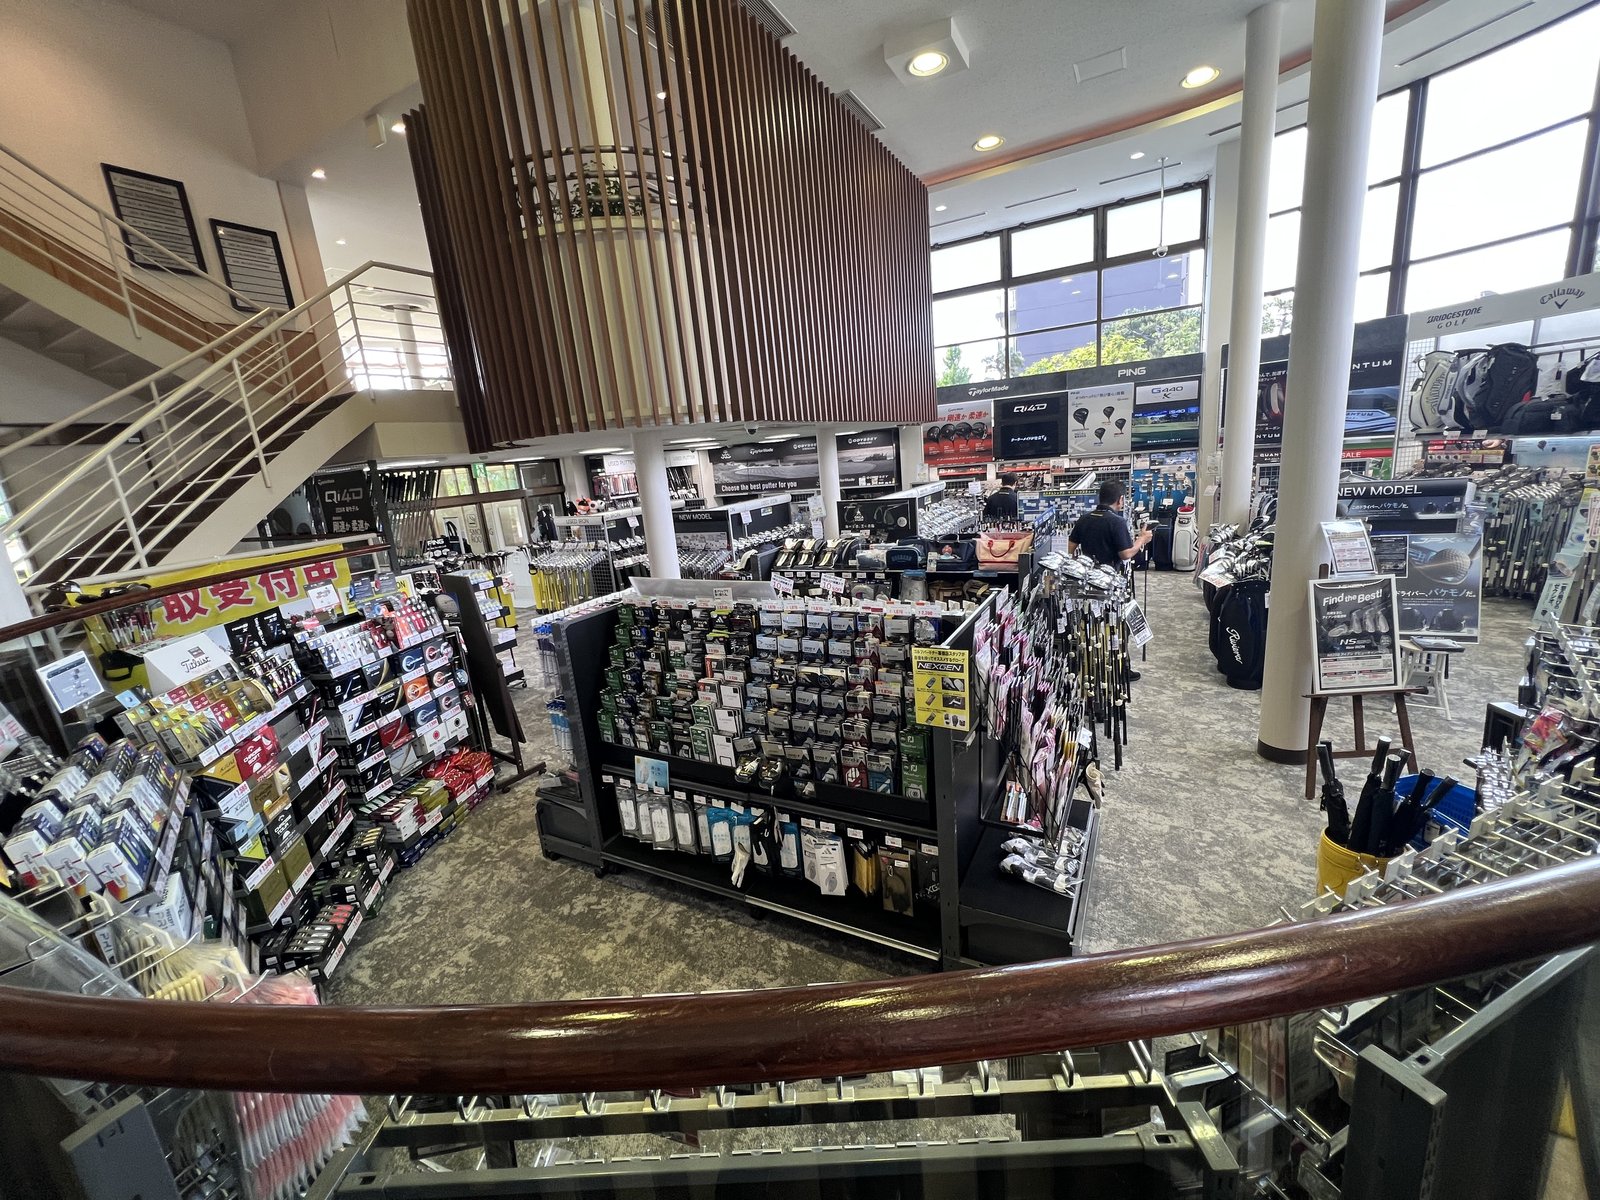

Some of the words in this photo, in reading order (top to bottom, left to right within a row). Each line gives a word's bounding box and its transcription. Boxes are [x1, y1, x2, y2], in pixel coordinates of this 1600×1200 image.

[1539, 287, 1586, 304] Callaway
[1427, 307, 1482, 323] BRIDGESTONE
[1437, 318, 1468, 329] GOLF
[1352, 360, 1392, 370] NTUM
[1118, 367, 1146, 377] PING
[968, 385, 1009, 396] TaylorMade
[1152, 386, 1183, 394] G440
[721, 484, 739, 492] Choose
[762, 482, 777, 490] putter
[1337, 486, 1366, 497] NEW
[1370, 485, 1422, 495] MODEL
[773, 582, 782, 590] 10
[823, 582, 832, 590] 10
[1322, 593, 1345, 606] Find
[1345, 594, 1357, 603] the
[1357, 589, 1383, 603] Best!
[180, 657, 211, 673] Titleist
[918, 662, 961, 671] NEXGEN
